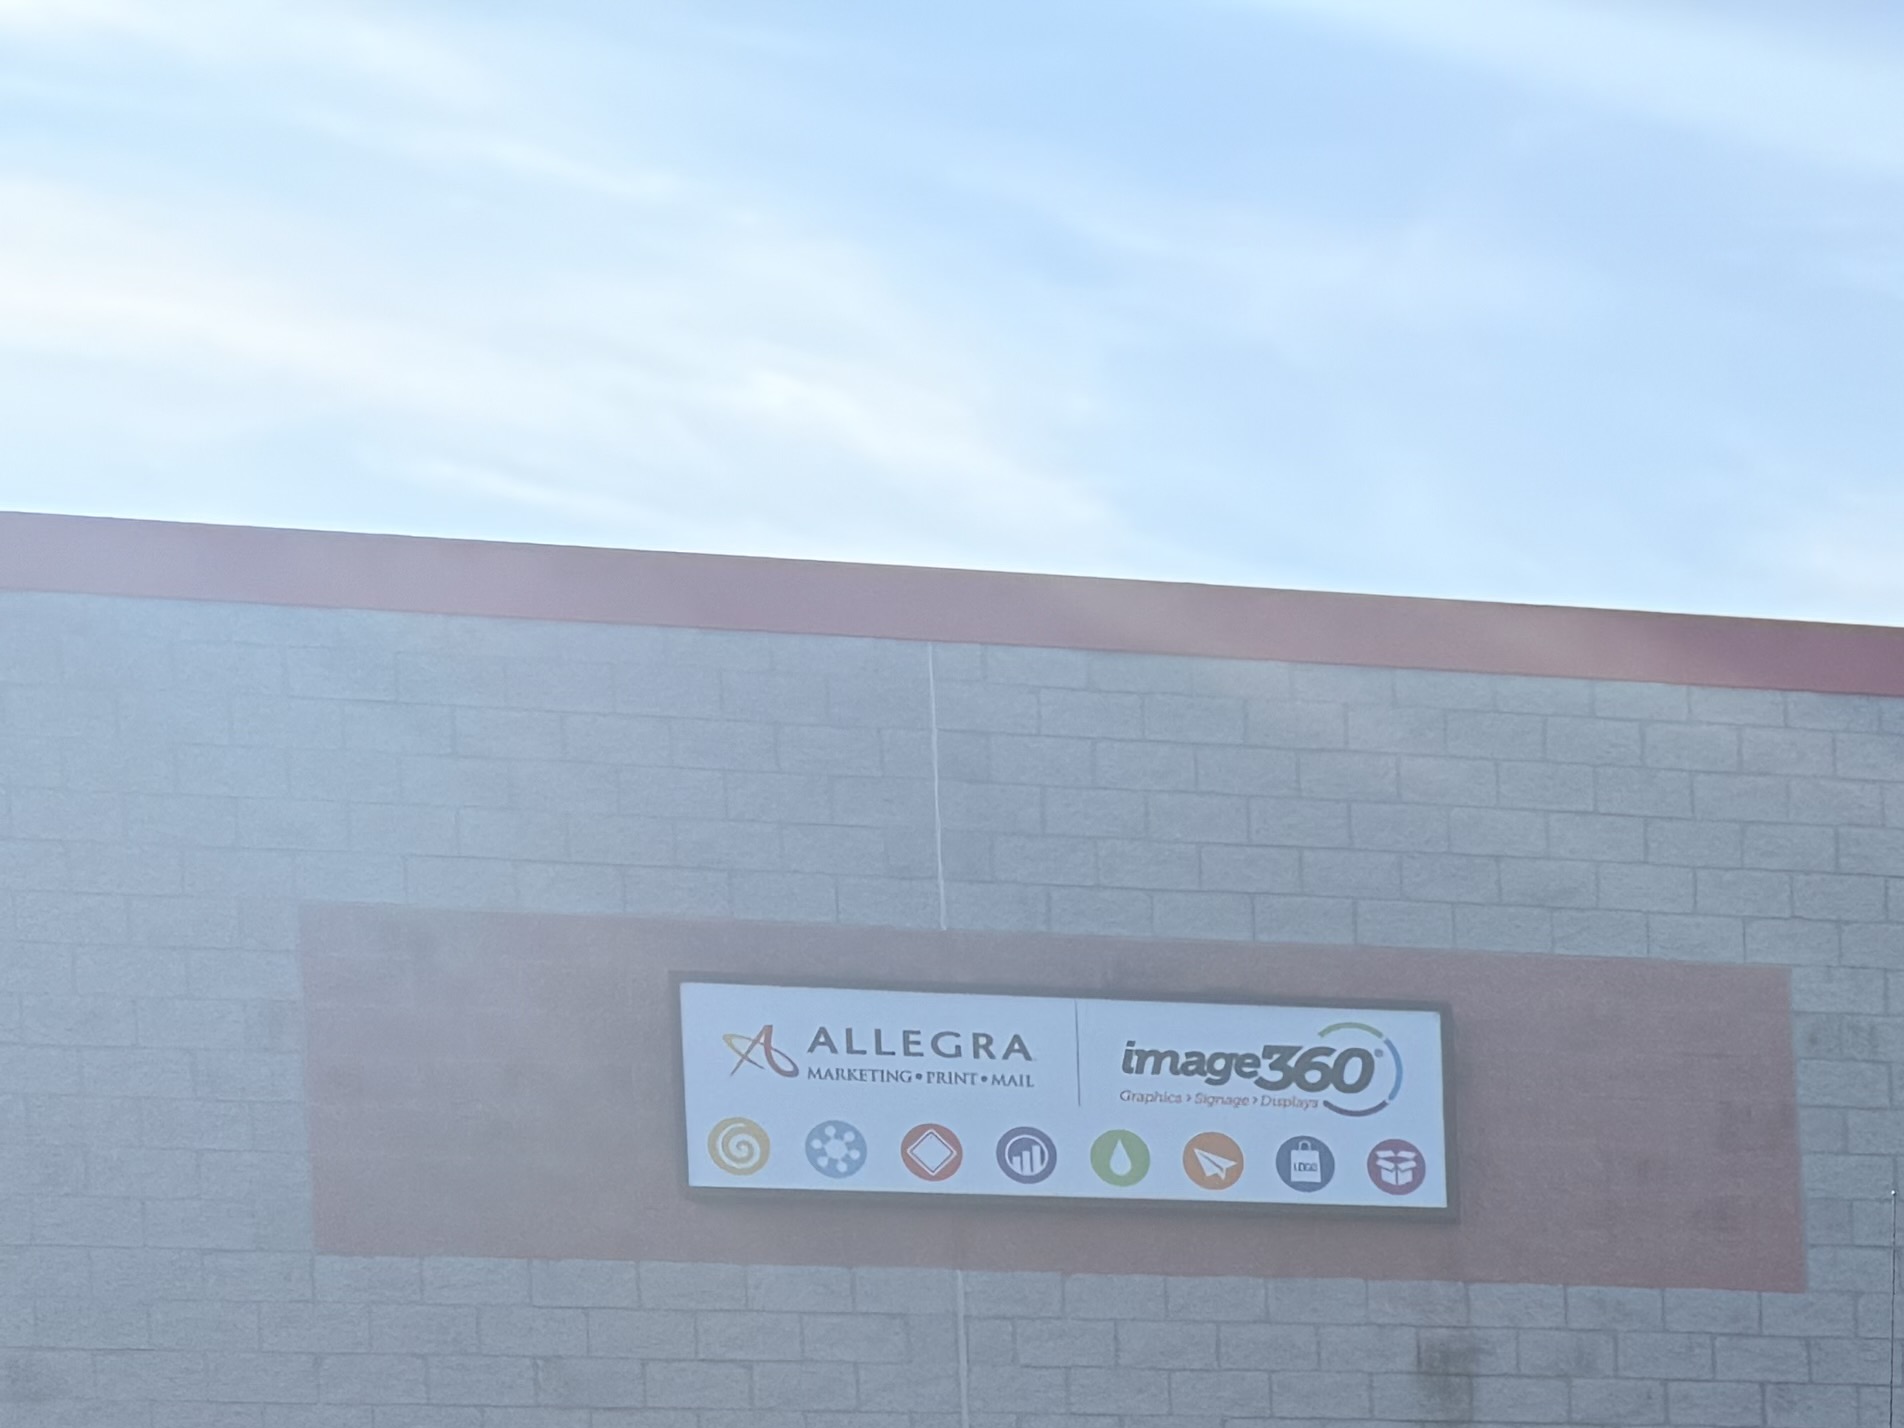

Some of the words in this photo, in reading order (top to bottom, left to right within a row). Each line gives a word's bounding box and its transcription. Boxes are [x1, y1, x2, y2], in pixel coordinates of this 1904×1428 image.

[807, 1026, 1033, 1062] ALLEGRA
[807, 1066, 913, 1084] MARKETING
[926, 1070, 979, 1086] PRINT
[991, 1073, 1035, 1088] MAIL
[1119, 1089, 1183, 1105] Graphics
[1194, 1092, 1250, 1109] Signage
[1260, 1094, 1319, 1111] Displays
